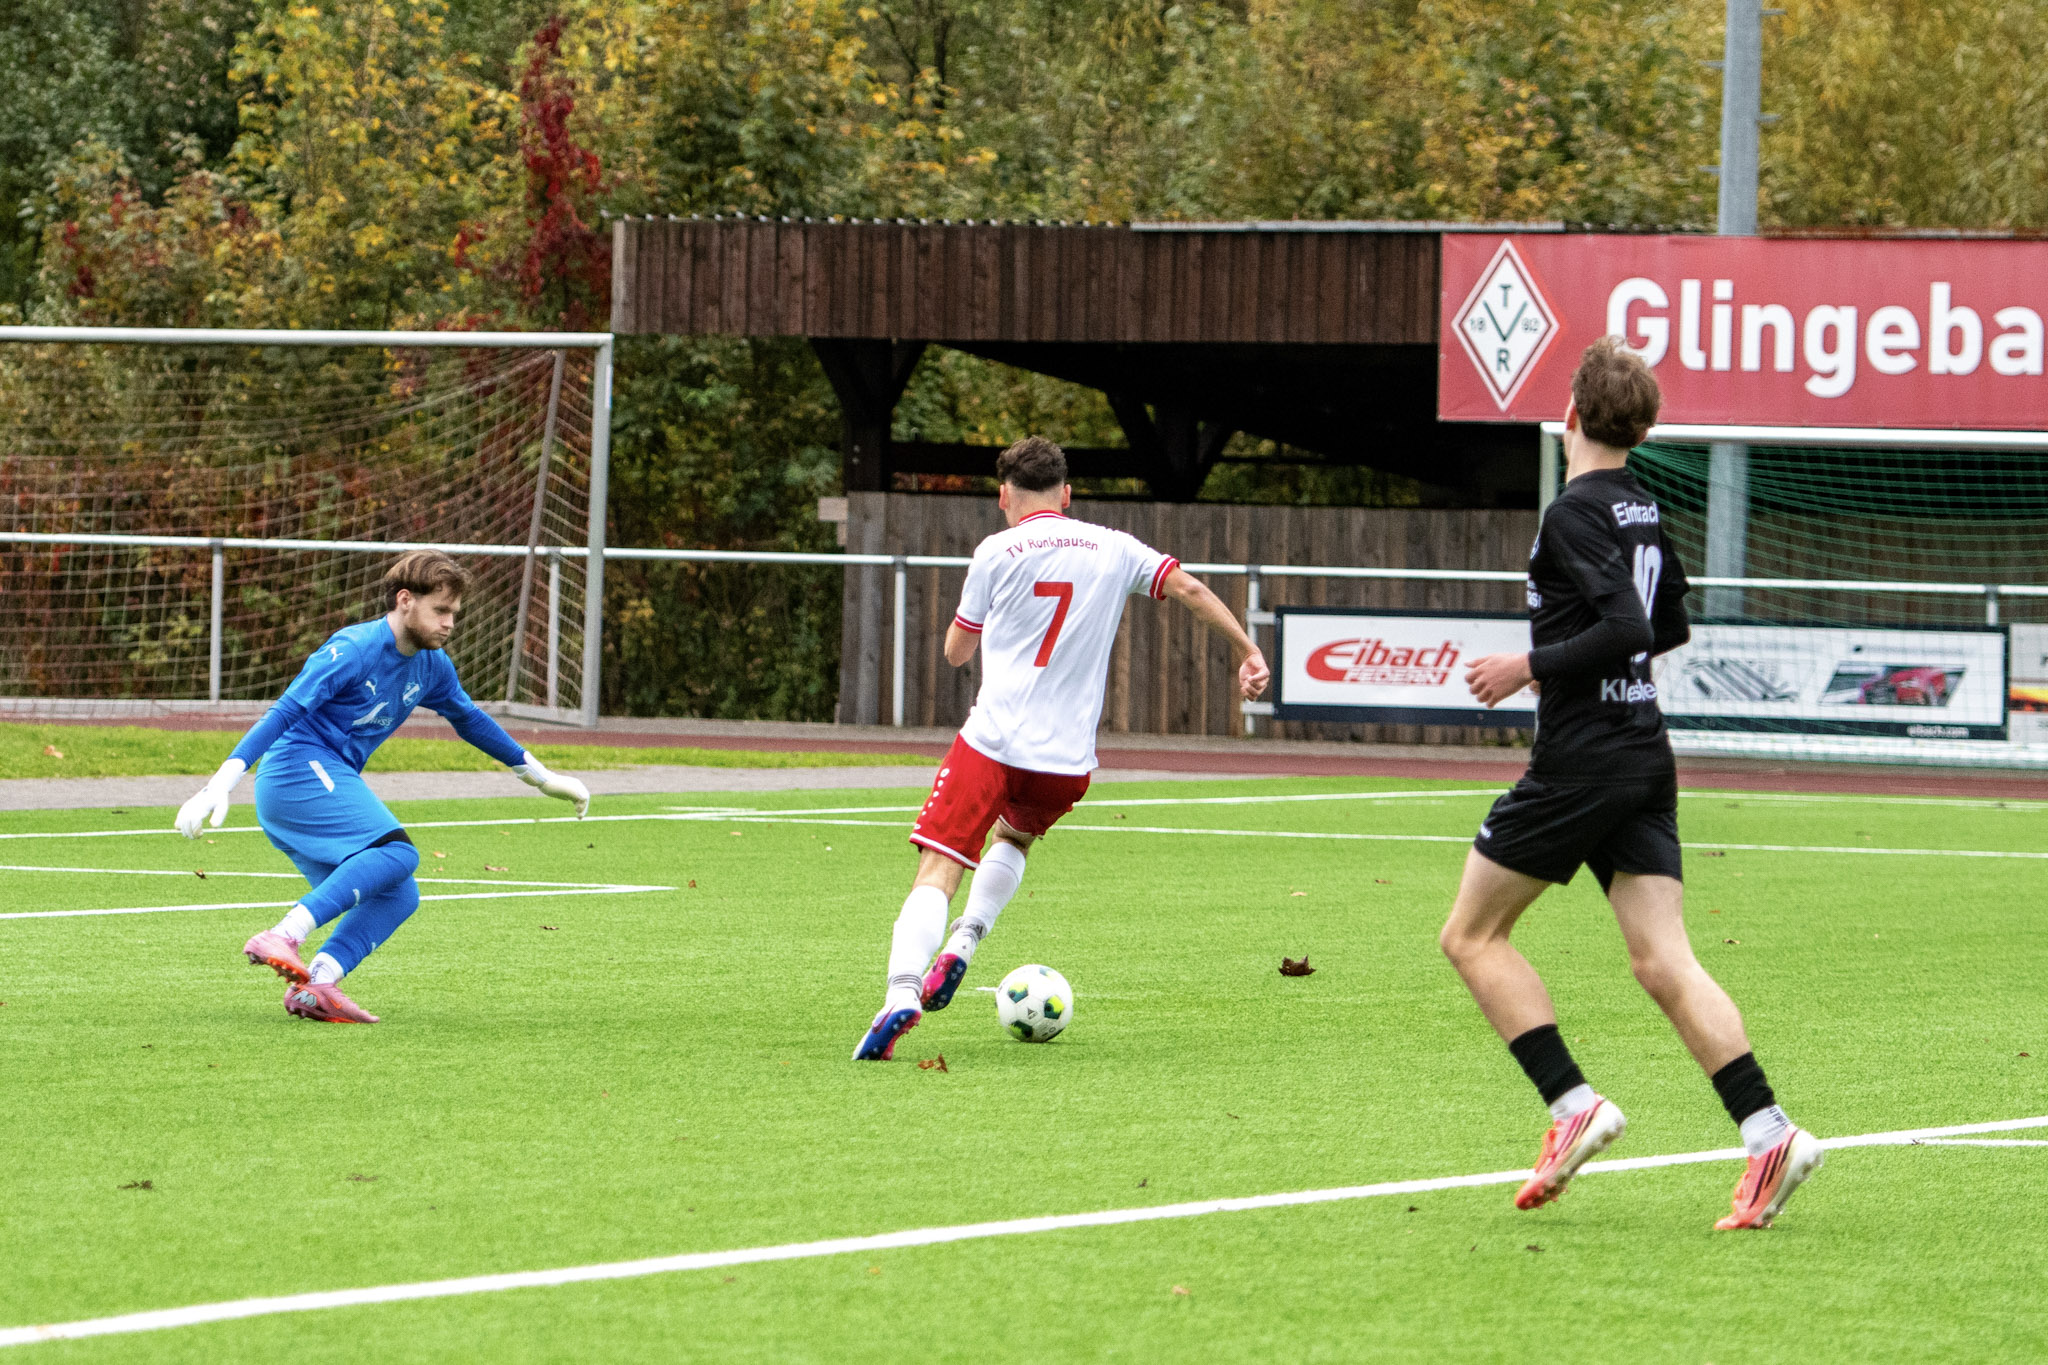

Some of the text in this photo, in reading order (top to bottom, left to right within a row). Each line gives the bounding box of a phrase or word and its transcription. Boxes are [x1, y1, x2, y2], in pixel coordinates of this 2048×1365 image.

[1606, 277, 2044, 398] Glingeba
[1006, 541, 1024, 558] TV
[1033, 581, 1073, 667] 7
[1306, 637, 1461, 682] Eibach
